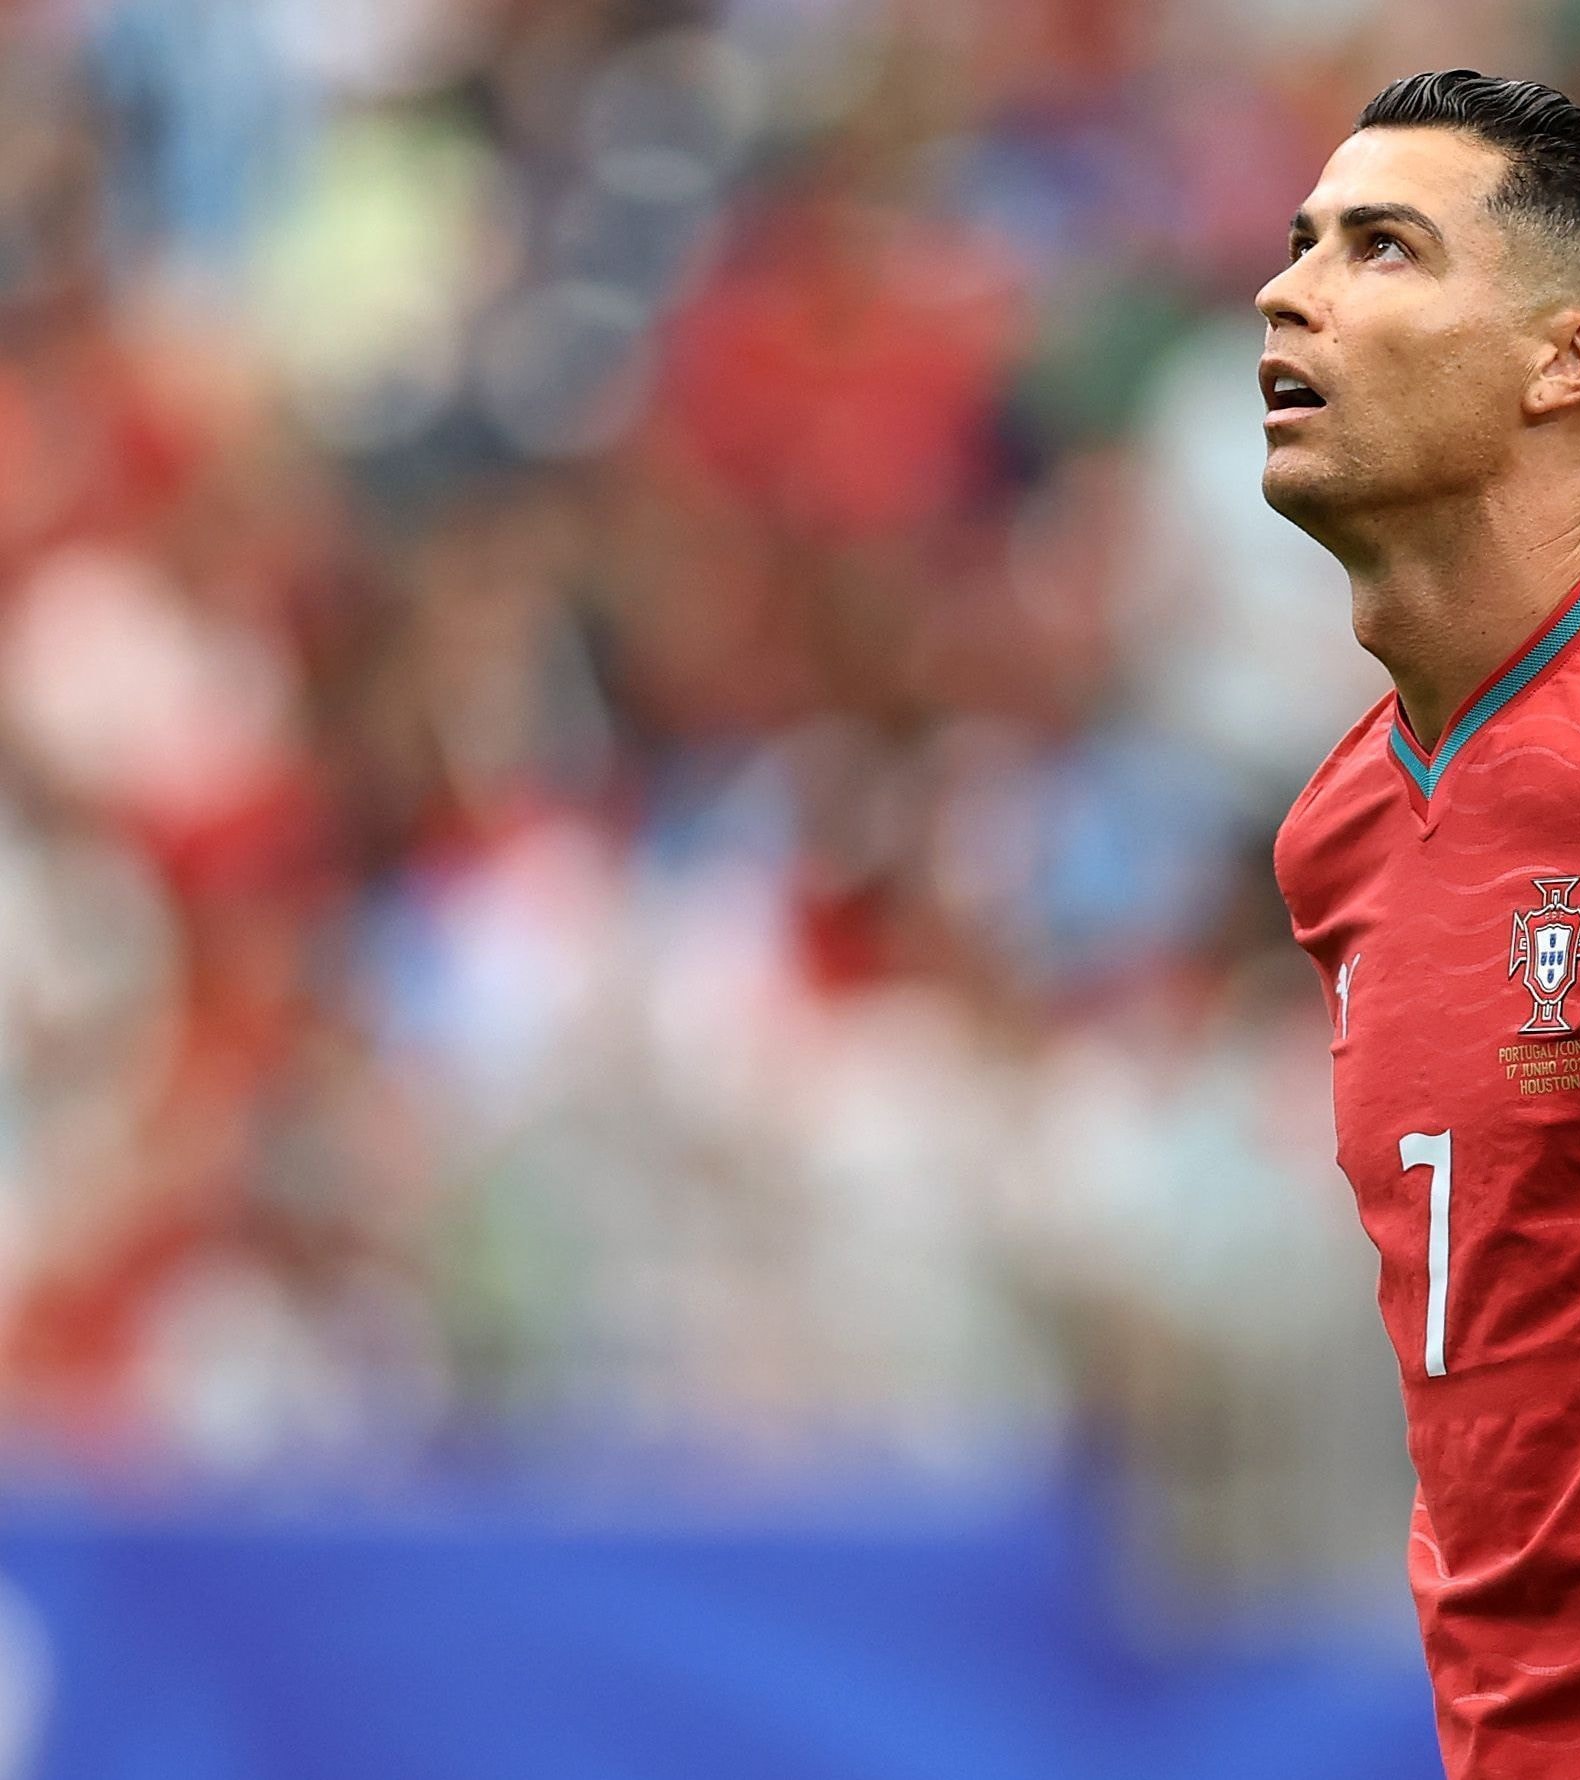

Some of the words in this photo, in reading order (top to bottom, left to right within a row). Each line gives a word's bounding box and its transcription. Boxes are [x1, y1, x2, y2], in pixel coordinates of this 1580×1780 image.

[1506, 1064, 1518, 1080] 17
[1520, 1060, 1557, 1077] JUNHO
[1520, 1074, 1580, 1095] HOUSTON
[1398, 1128, 1451, 1377] 7
